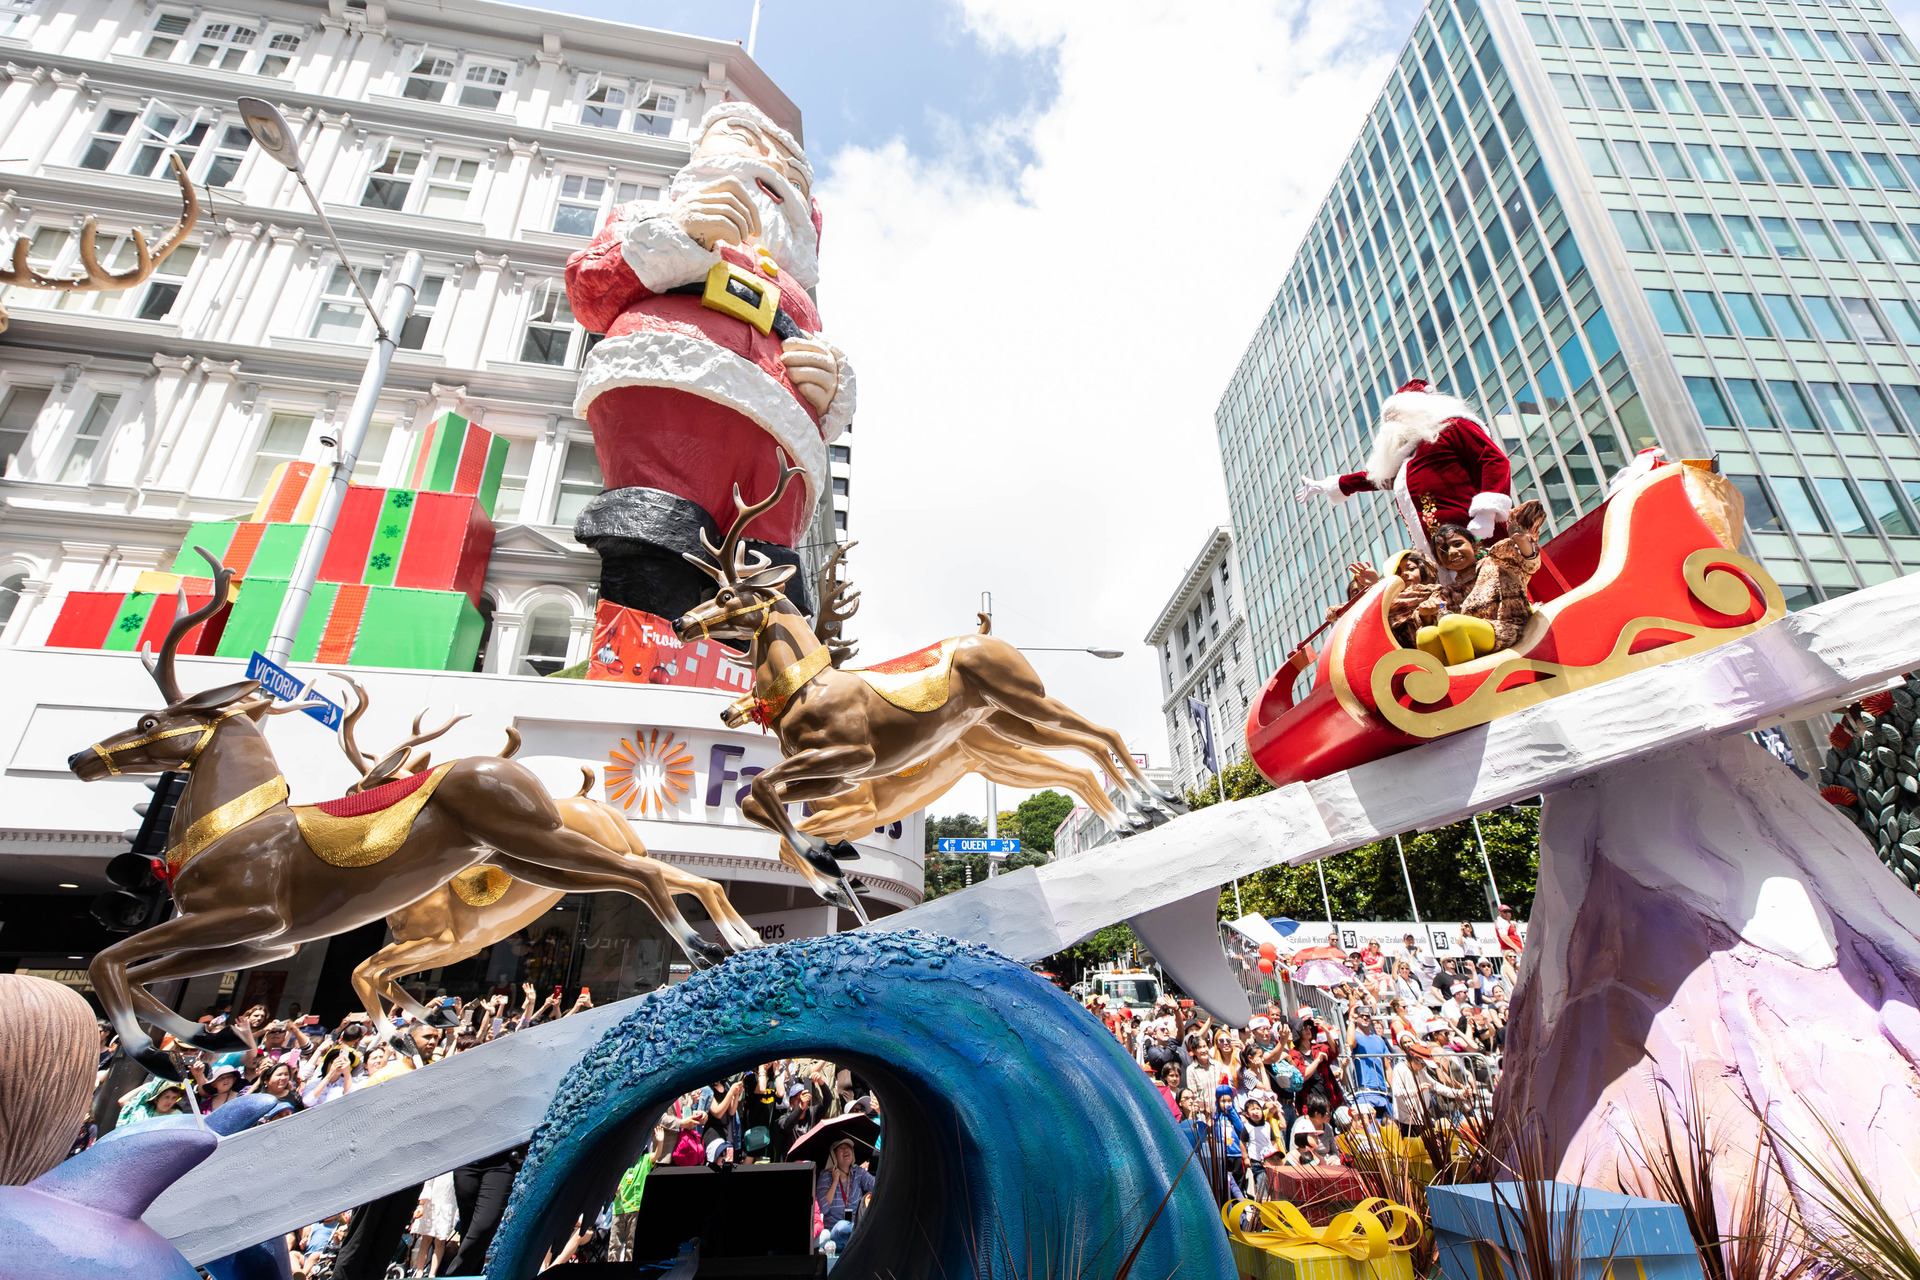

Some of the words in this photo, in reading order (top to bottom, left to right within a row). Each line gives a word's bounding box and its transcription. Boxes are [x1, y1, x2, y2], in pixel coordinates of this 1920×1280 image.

[641, 624, 684, 649] From
[254, 659, 298, 701] VICTORIA
[961, 840, 987, 850] QUEEN
[755, 924, 785, 941] mers
[1312, 936, 1328, 944] Heral
[55, 970, 90, 981] CLINI
